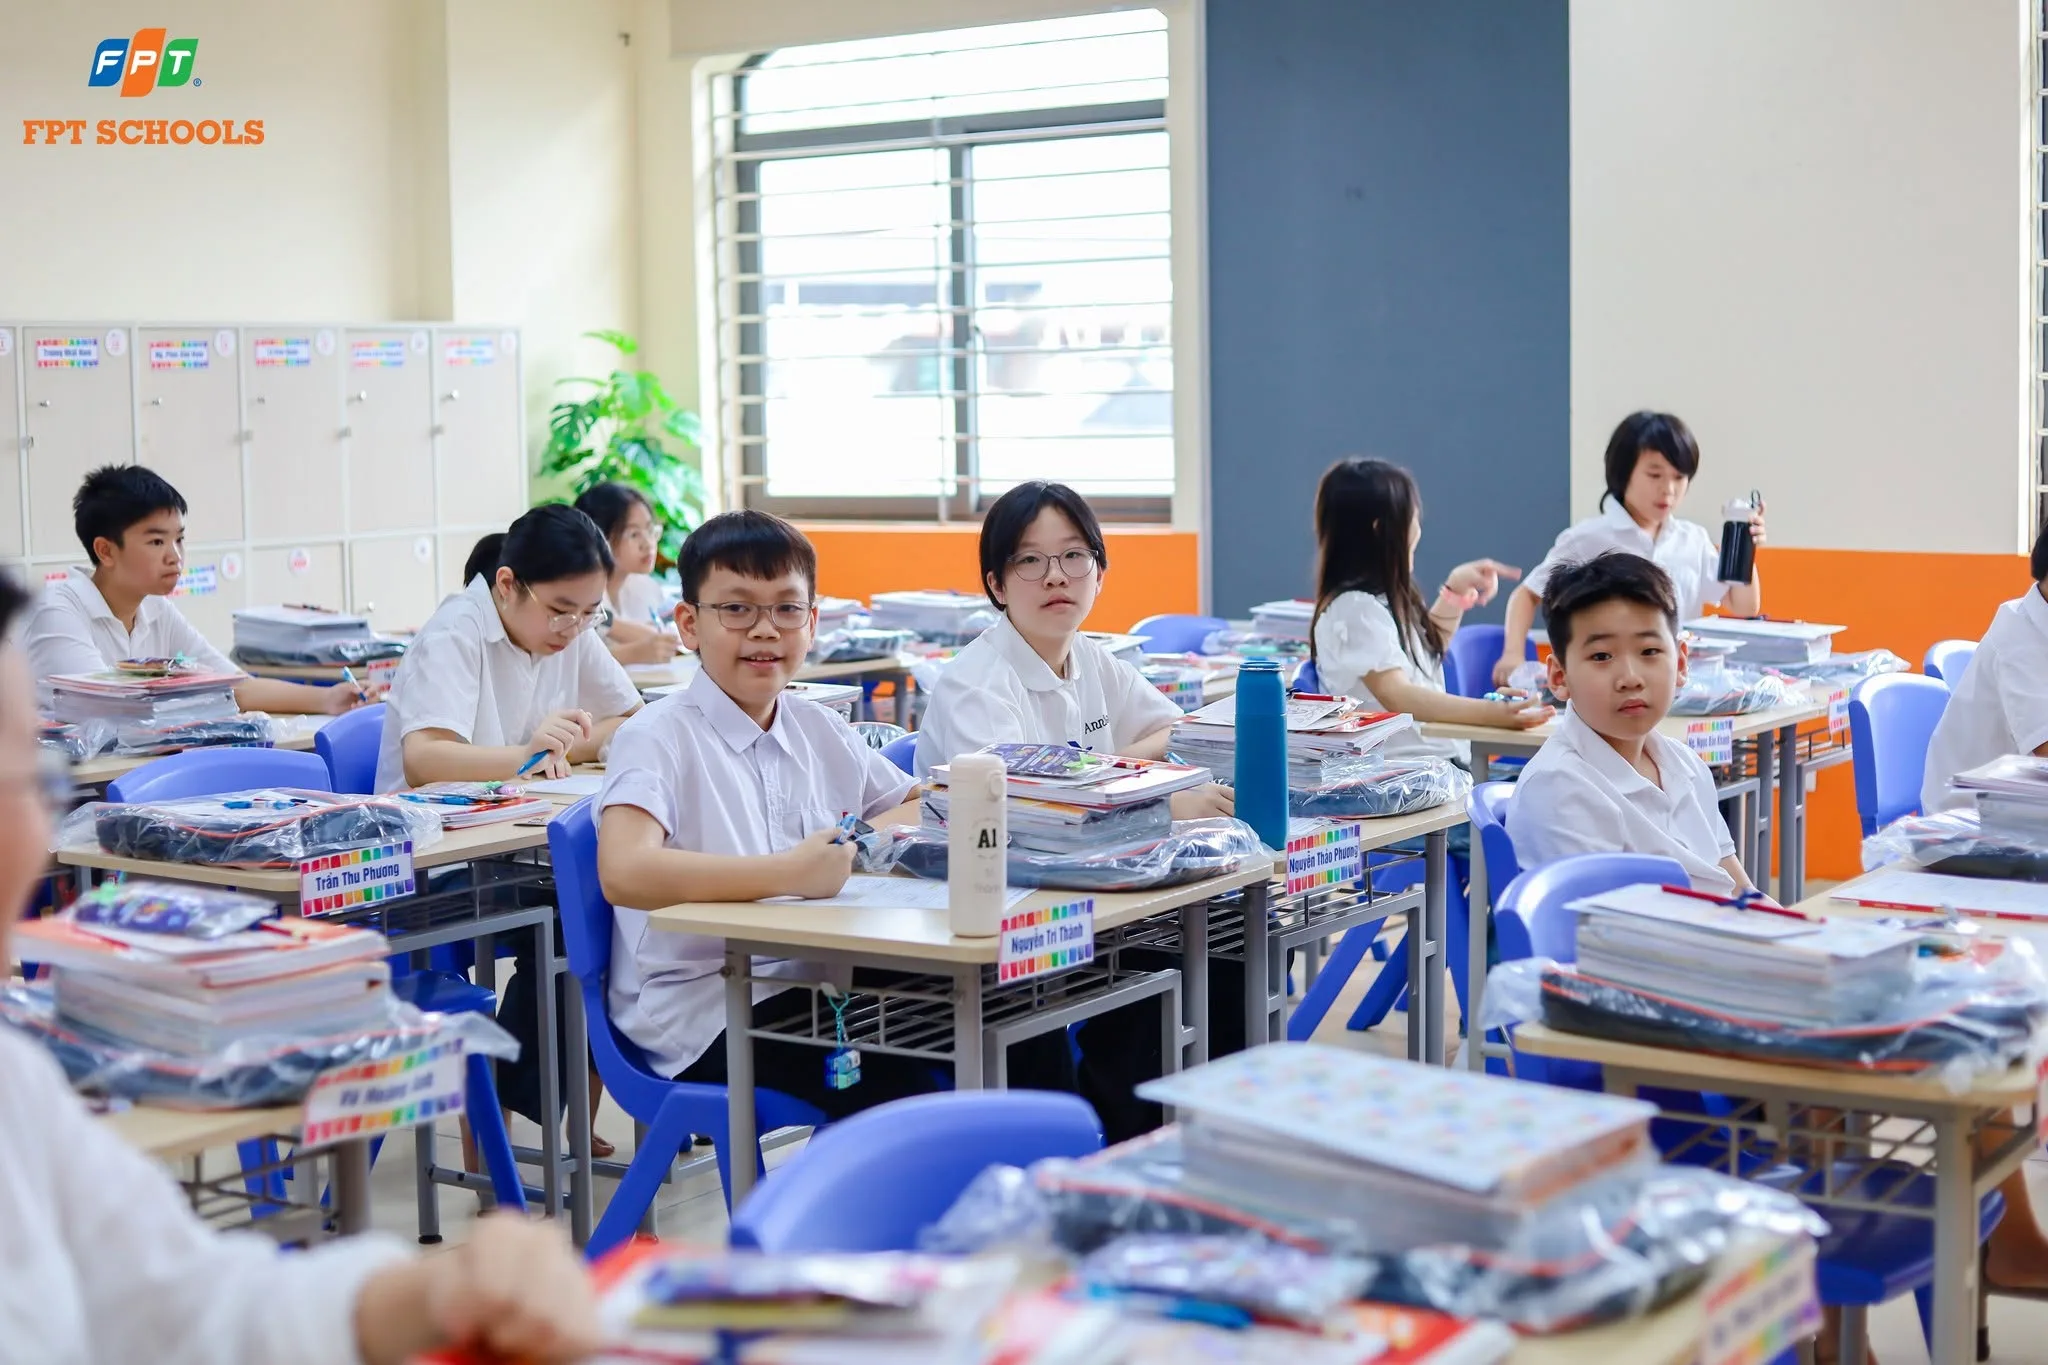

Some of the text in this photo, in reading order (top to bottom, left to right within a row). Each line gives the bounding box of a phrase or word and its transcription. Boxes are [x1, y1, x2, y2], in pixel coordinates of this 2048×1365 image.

[1289, 850, 1316, 874] Nguyễn
[1317, 847, 1333, 867] Thảo
[316, 863, 400, 892] Trần Thu Phương
[1011, 927, 1045, 954] Nguyễn
